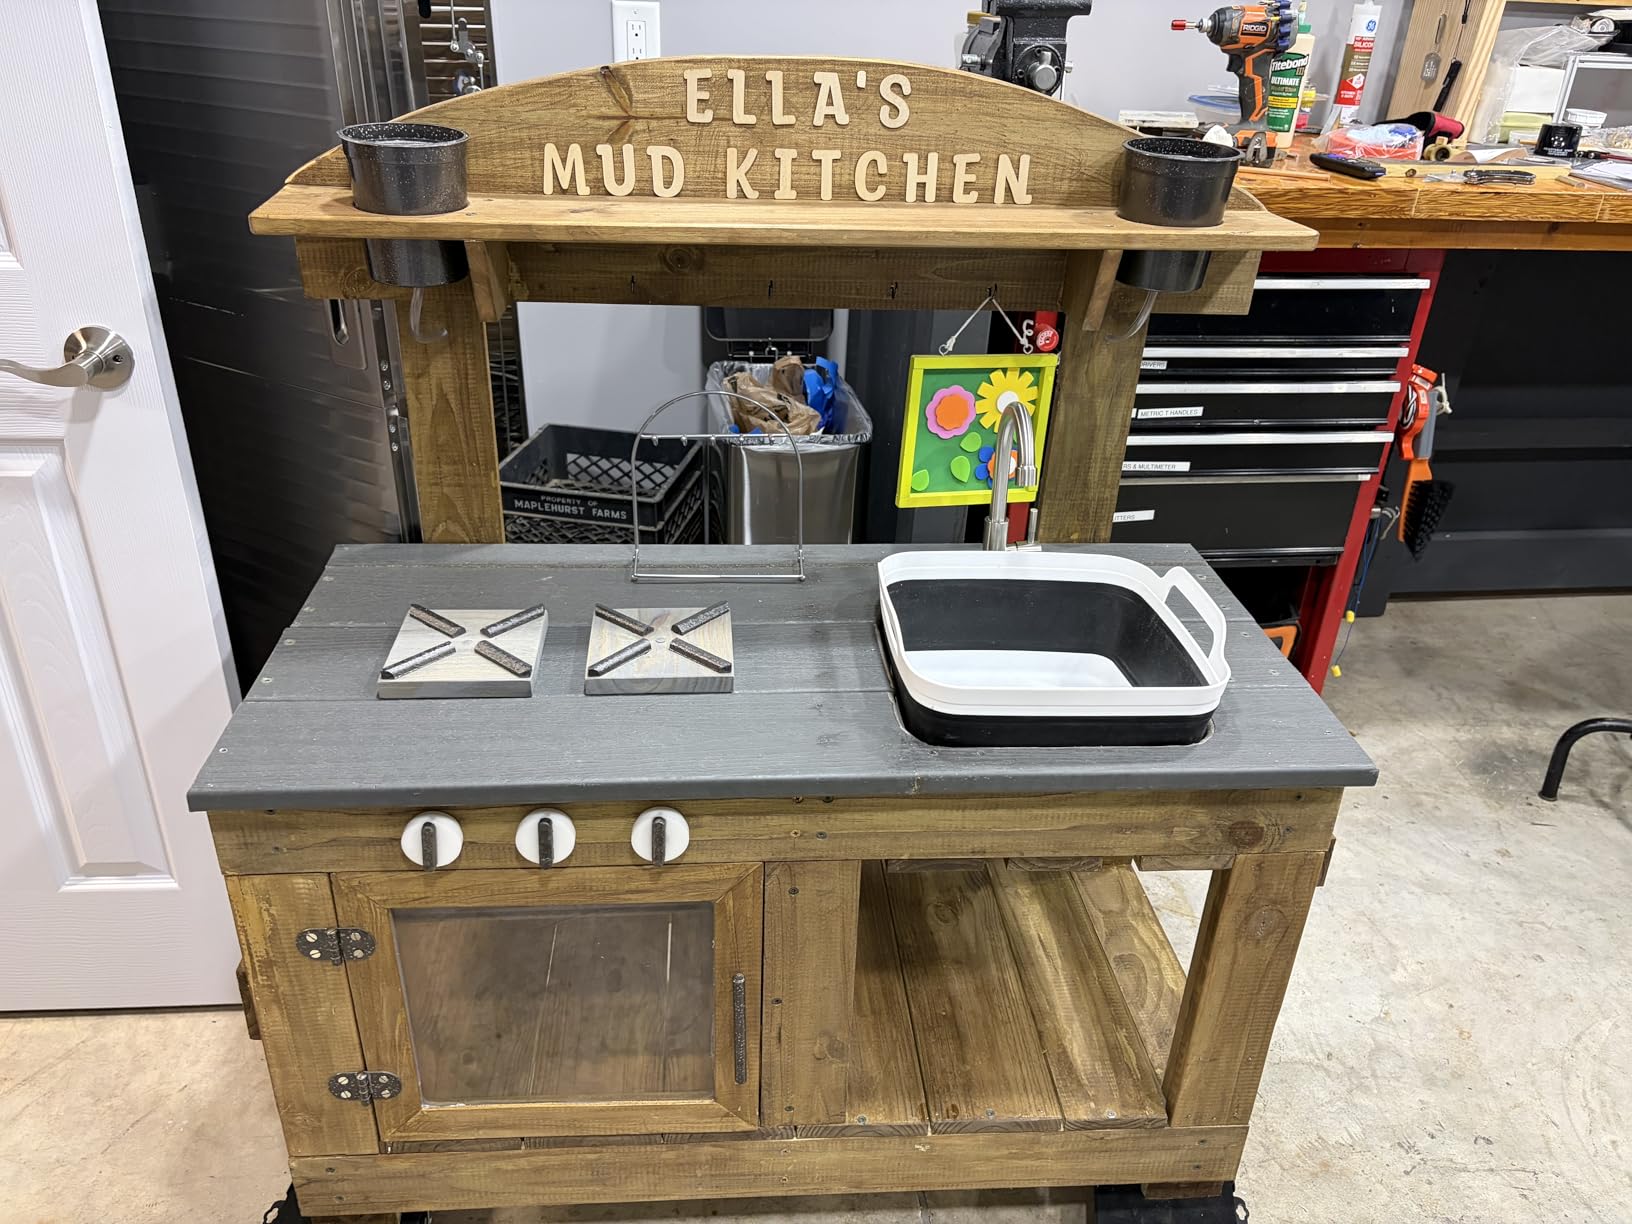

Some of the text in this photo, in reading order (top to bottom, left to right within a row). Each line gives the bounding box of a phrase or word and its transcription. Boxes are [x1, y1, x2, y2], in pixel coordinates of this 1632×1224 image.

[1242, 24, 1267, 32] RIDGID
[1271, 56, 1309, 71] Titebond
[1271, 77, 1300, 86] ULTIMATE
[683, 68, 912, 129] ELLA'S
[543, 142, 1033, 204] MUD KITCHEN
[541, 495, 581, 505] PROPERTY
[514, 499, 627, 520] MAPLEHURST FARMS
